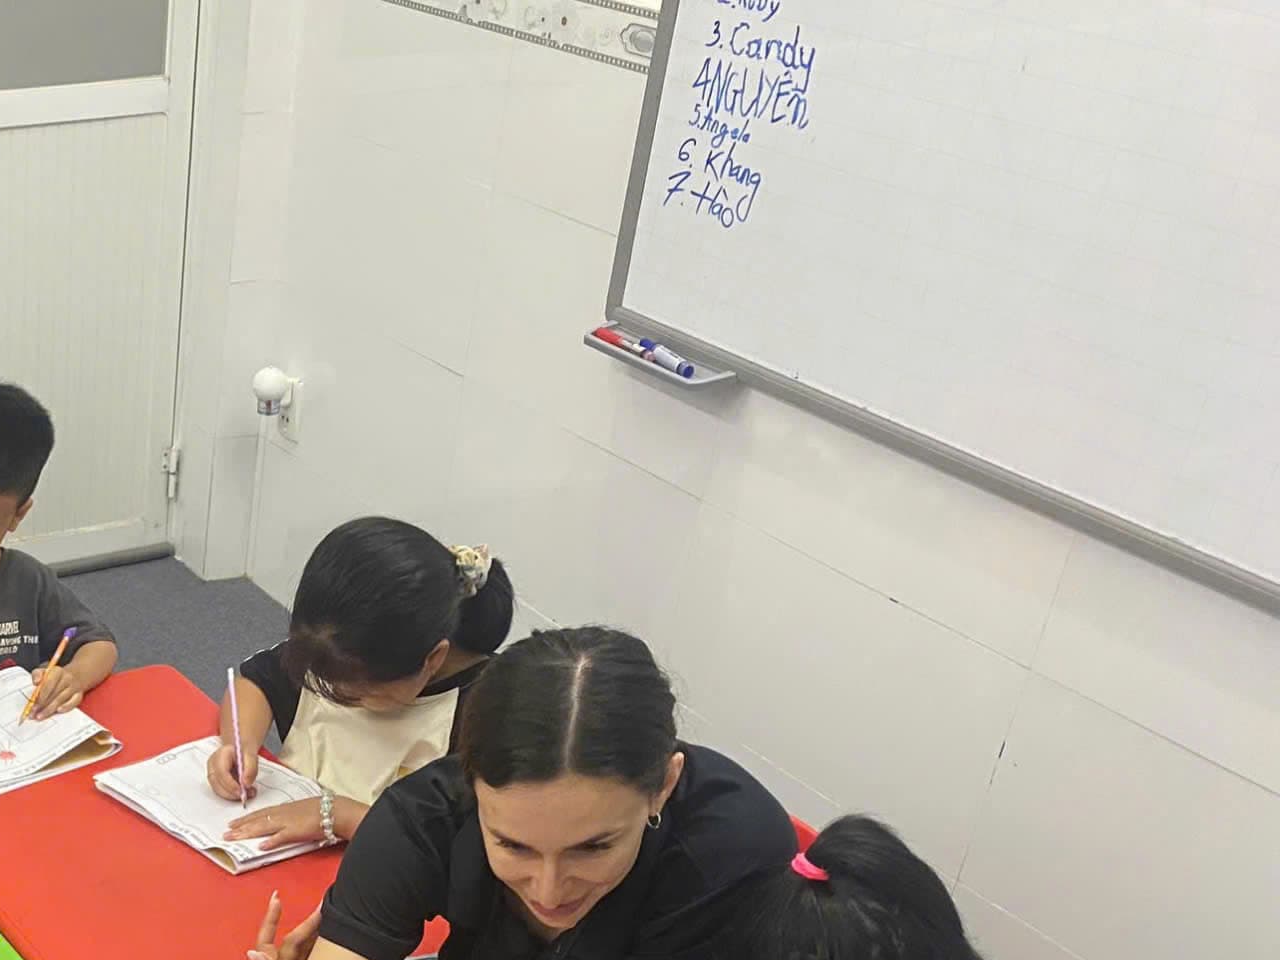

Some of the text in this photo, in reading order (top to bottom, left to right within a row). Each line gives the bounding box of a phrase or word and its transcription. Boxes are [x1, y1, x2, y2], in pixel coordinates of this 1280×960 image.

[729, 22, 816, 94] Candy
[703, 141, 762, 223] Khang
[23, 635, 39, 645] THE
